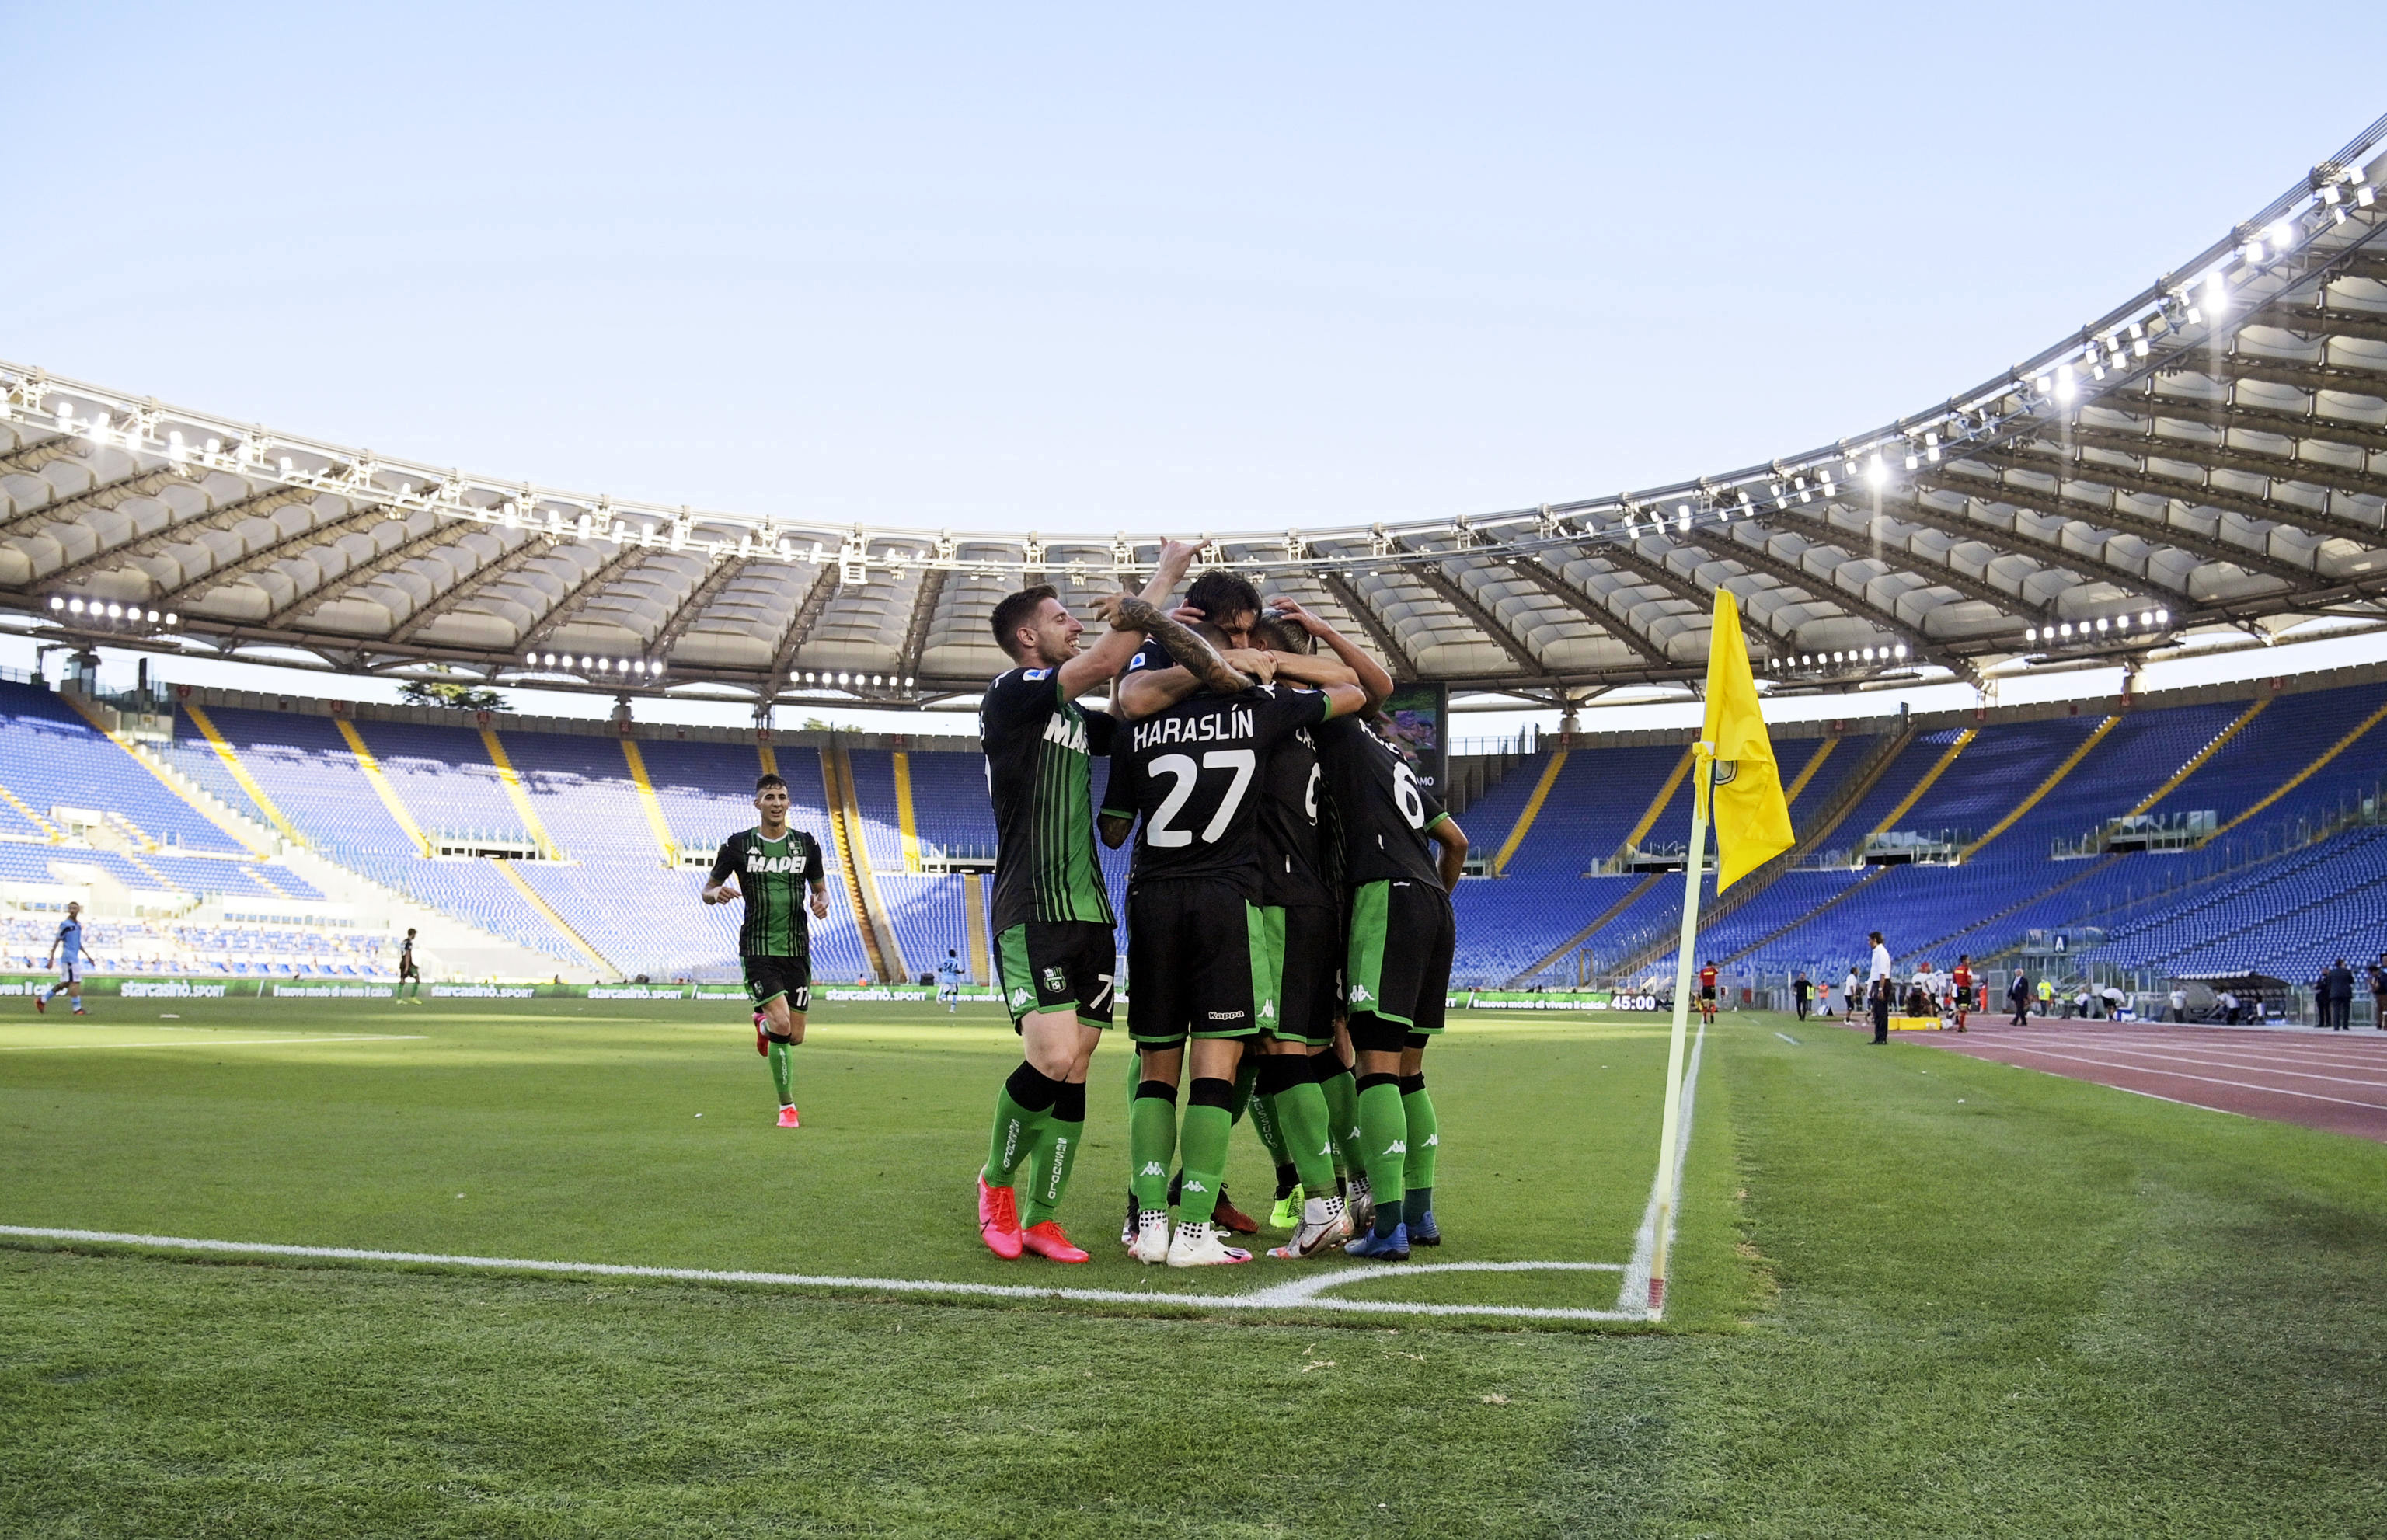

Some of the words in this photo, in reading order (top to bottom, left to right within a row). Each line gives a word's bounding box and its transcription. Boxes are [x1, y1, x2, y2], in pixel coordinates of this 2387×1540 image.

[1134, 703, 1253, 752] HARASLÍN
[1147, 749, 1256, 848] 27
[1393, 761, 1425, 829] 6
[746, 855, 807, 873] MAPEI
[2054, 935, 2065, 952] A
[943, 962, 953, 973] 34
[1507, 999, 1535, 1009] modo
[1535, 999, 1545, 1009] di
[1545, 1000, 1573, 1009] vivere
[1580, 1001, 1608, 1009] calcio
[1611, 995, 1656, 1010] 45:00
[1208, 1010, 1245, 1020] Kappa
[1047, 1137, 1068, 1200] SASSUOLO
